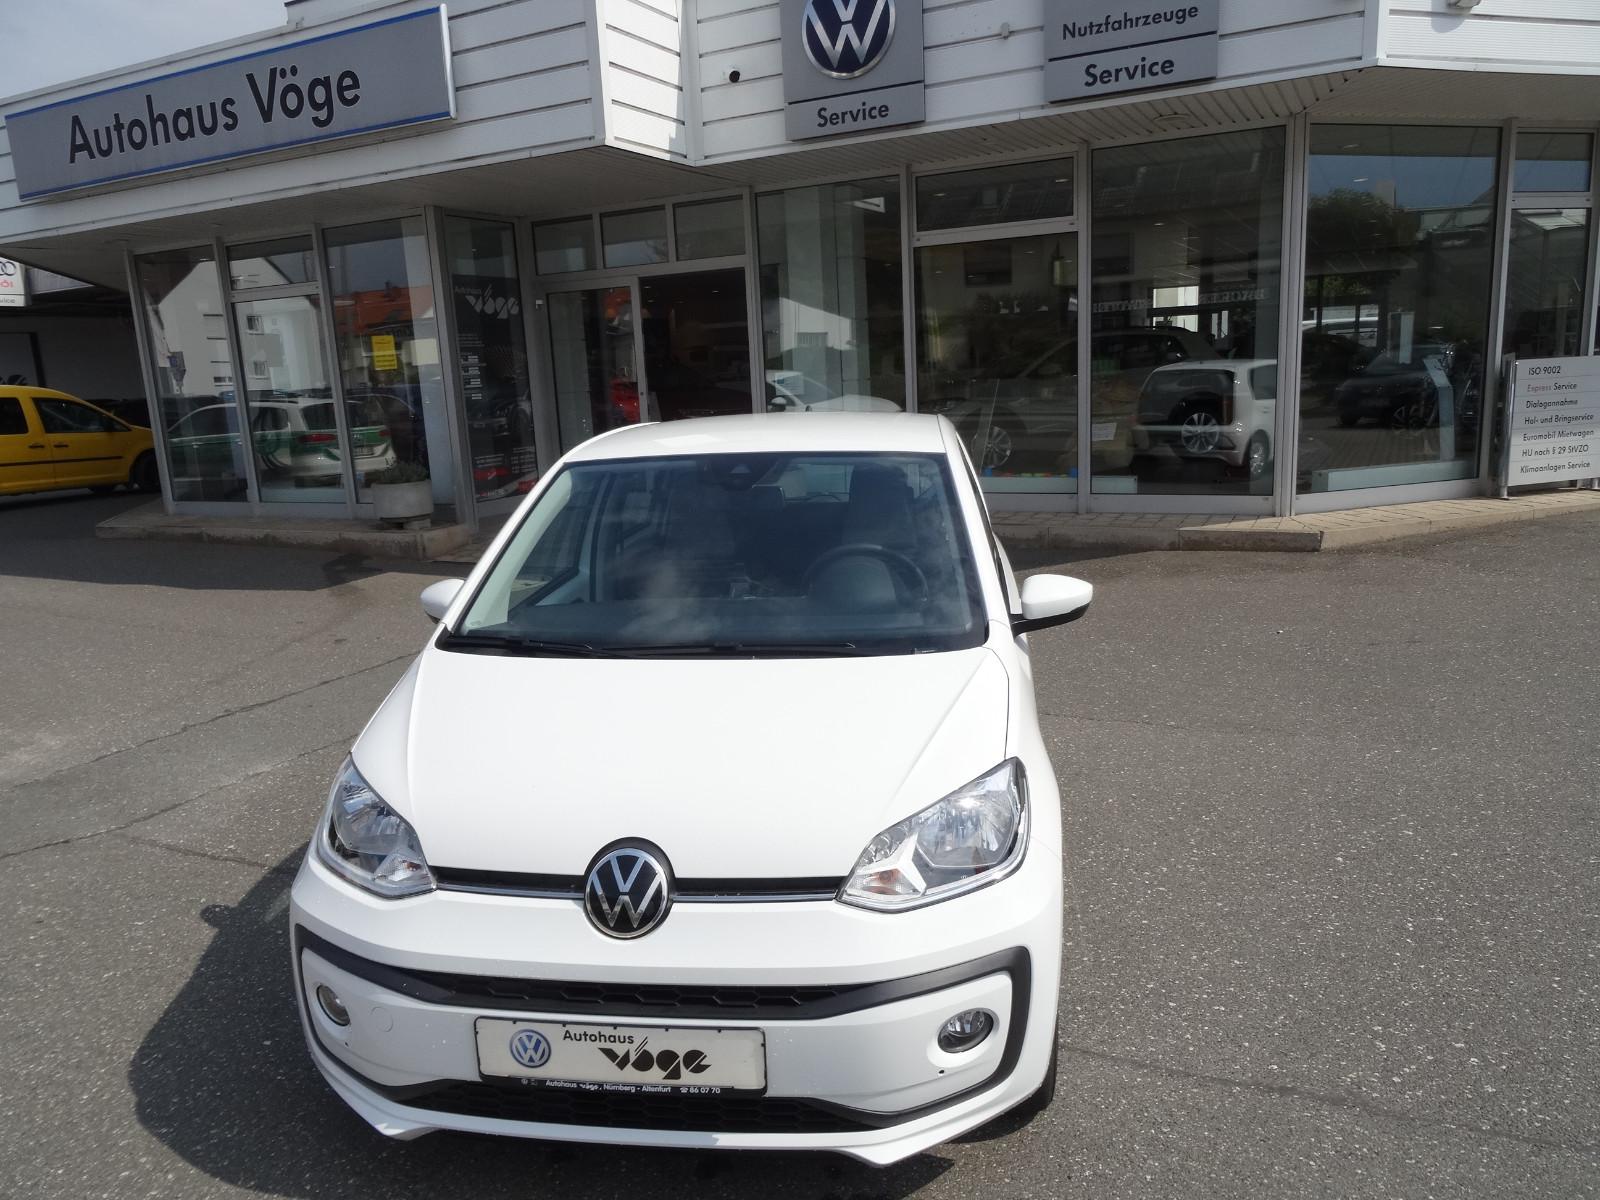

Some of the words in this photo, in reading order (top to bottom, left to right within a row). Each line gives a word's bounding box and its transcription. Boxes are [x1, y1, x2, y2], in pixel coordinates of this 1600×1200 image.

[1062, 4, 1199, 41] Nutzfahrzeuge
[1084, 56, 1175, 88] Service
[69, 94, 239, 164] Autohaus
[245, 64, 361, 128] Vöge
[816, 101, 890, 128] Service
[1543, 365, 1561, 375] 9002
[1553, 382, 1578, 391] Service
[1540, 415, 1553, 424] und
[1554, 412, 1594, 423] Bringservice
[1523, 431, 1556, 441] Euromobil
[1557, 429, 1594, 438] Mietwagen
[1521, 449, 1533, 457] HU
[1534, 447, 1550, 456] nach
[1557, 446, 1567, 455] 29
[1567, 444, 1589, 453] StVZO
[1520, 463, 1566, 474] Klimaanlagen
[1567, 461, 1591, 470] Service
[563, 1029, 635, 1045] Autohaus
[545, 1079, 578, 1089] Autohaus
[641, 1084, 671, 1093] Altenfurt
